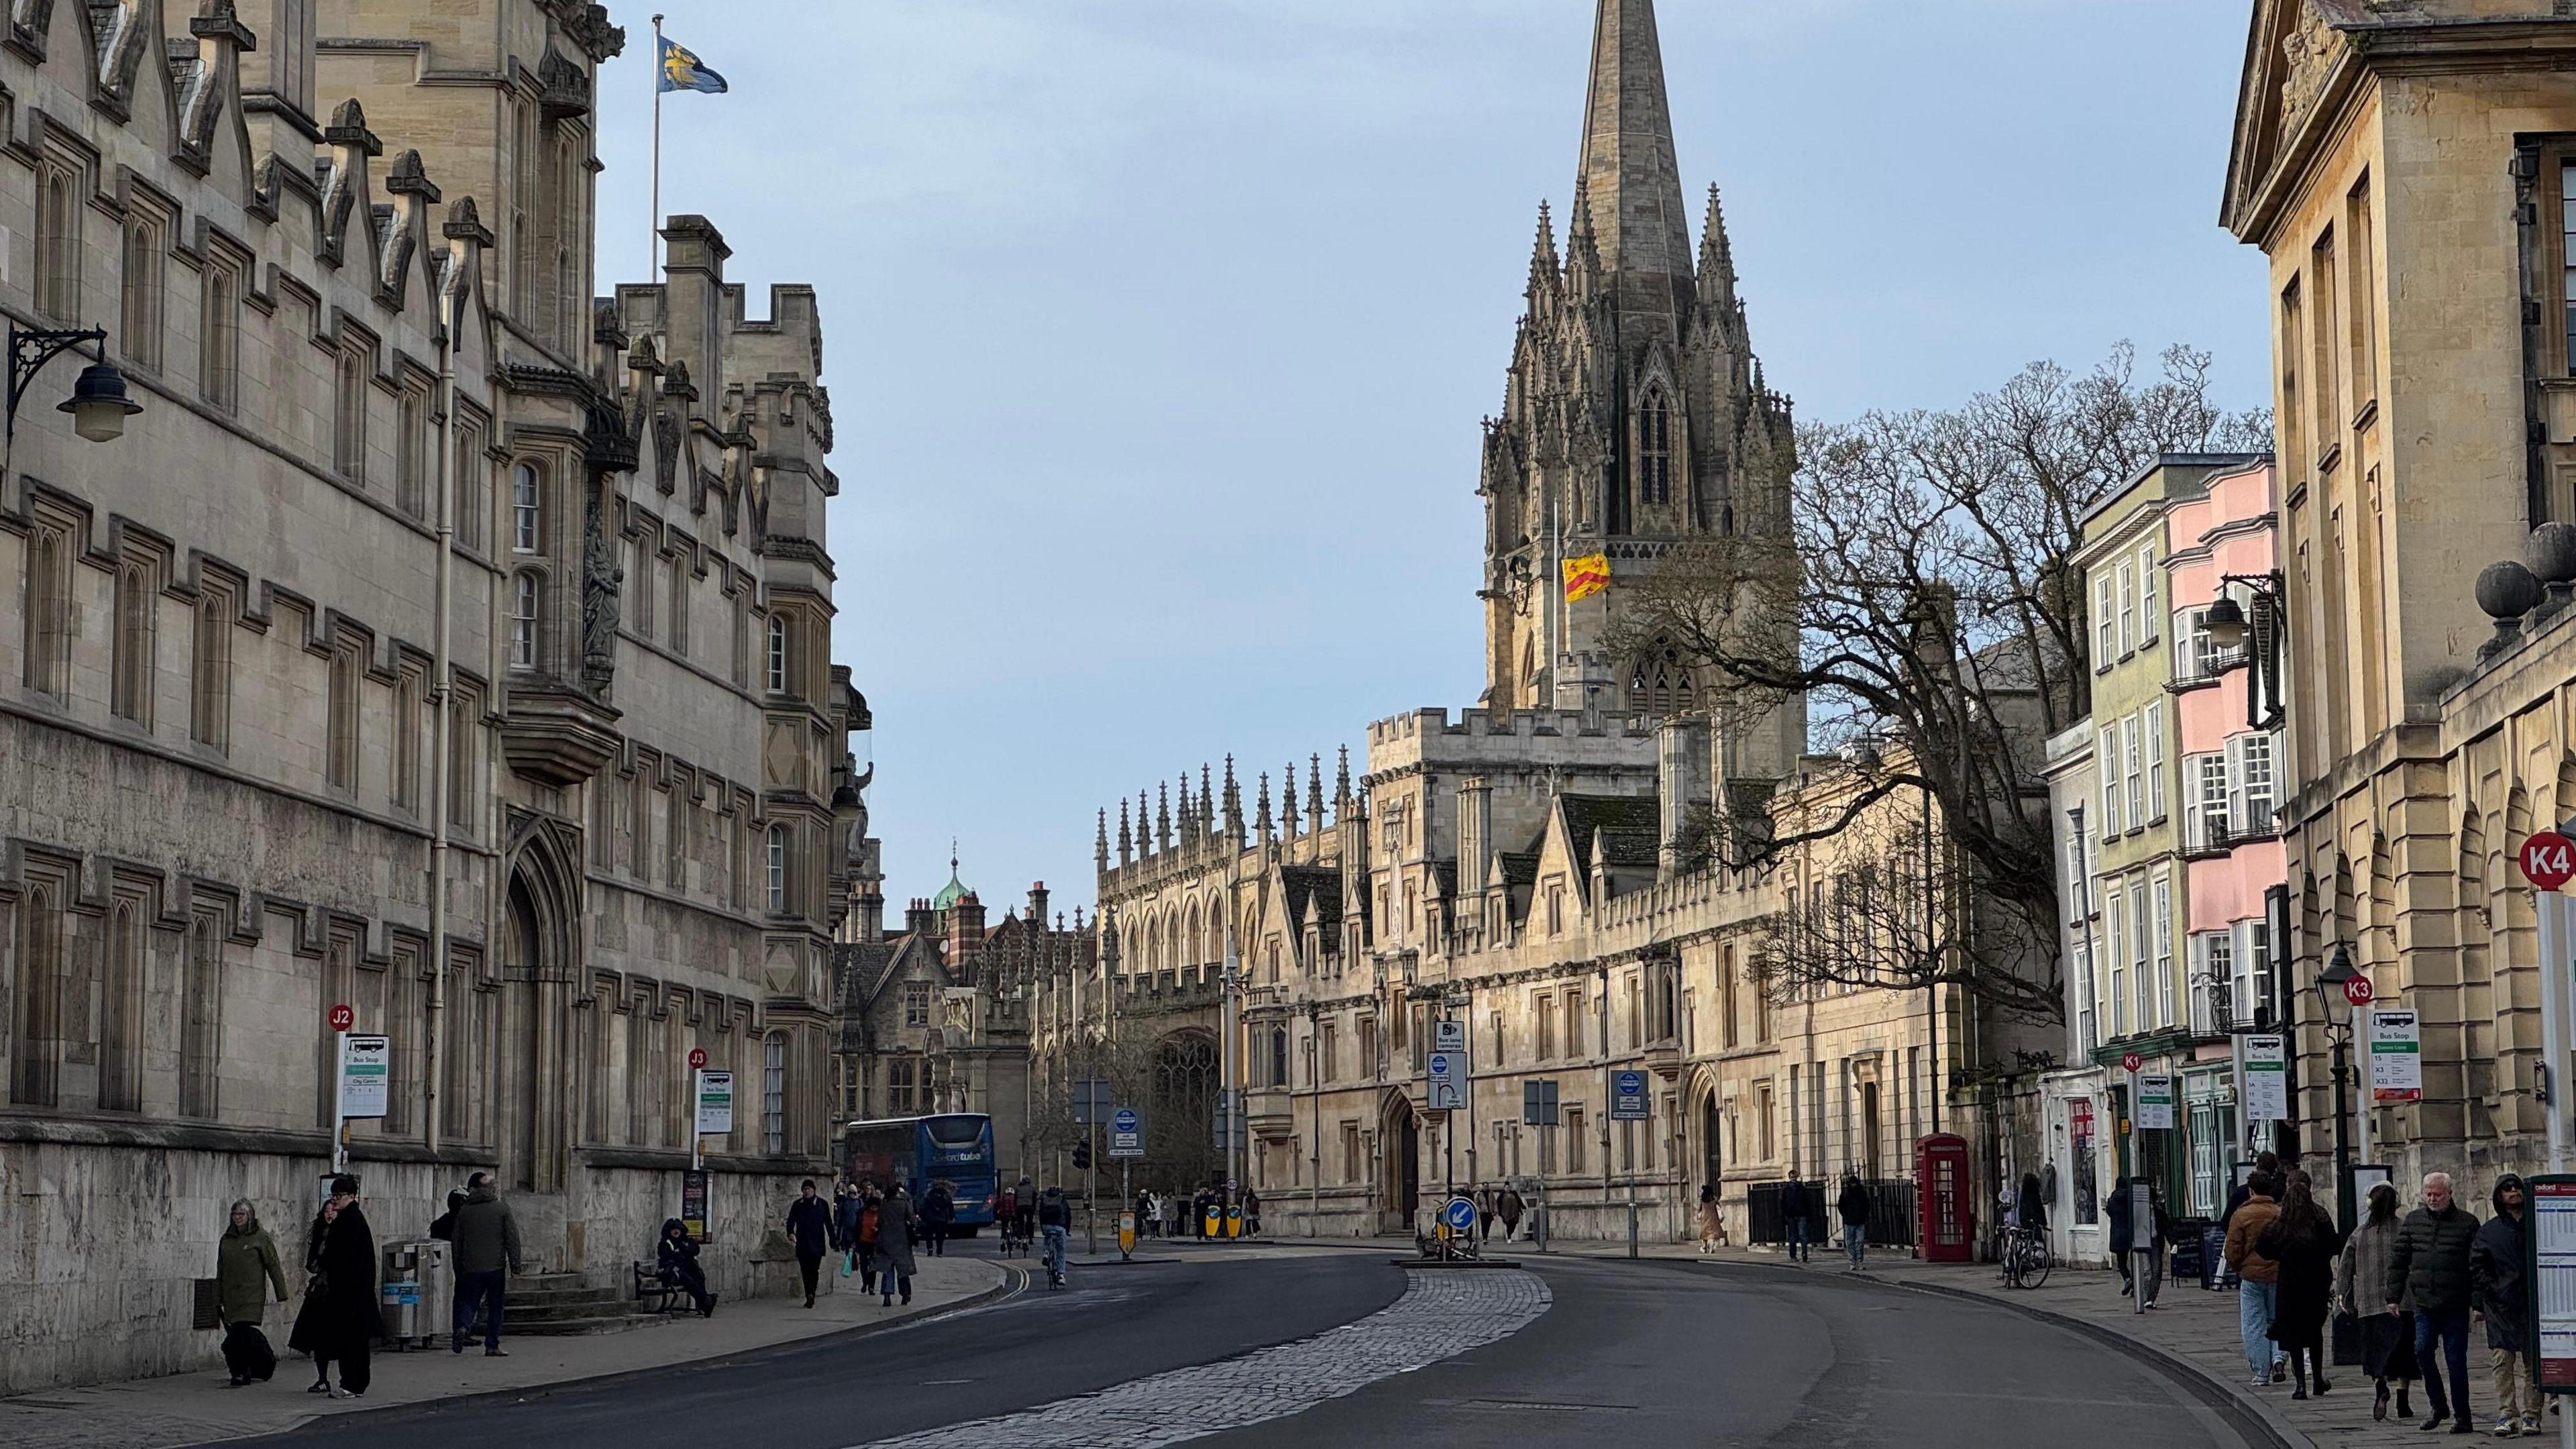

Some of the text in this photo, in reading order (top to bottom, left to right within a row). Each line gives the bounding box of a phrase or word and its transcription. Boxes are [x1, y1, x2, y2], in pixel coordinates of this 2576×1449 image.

[2530, 846, 2570, 874] K4
[2349, 982, 2369, 998] K3
[333, 1010, 349, 1024] J2
[692, 1053, 703, 1063] J3
[2125, 1056, 2139, 1067] K1
[961, 1152, 981, 1161] tube
